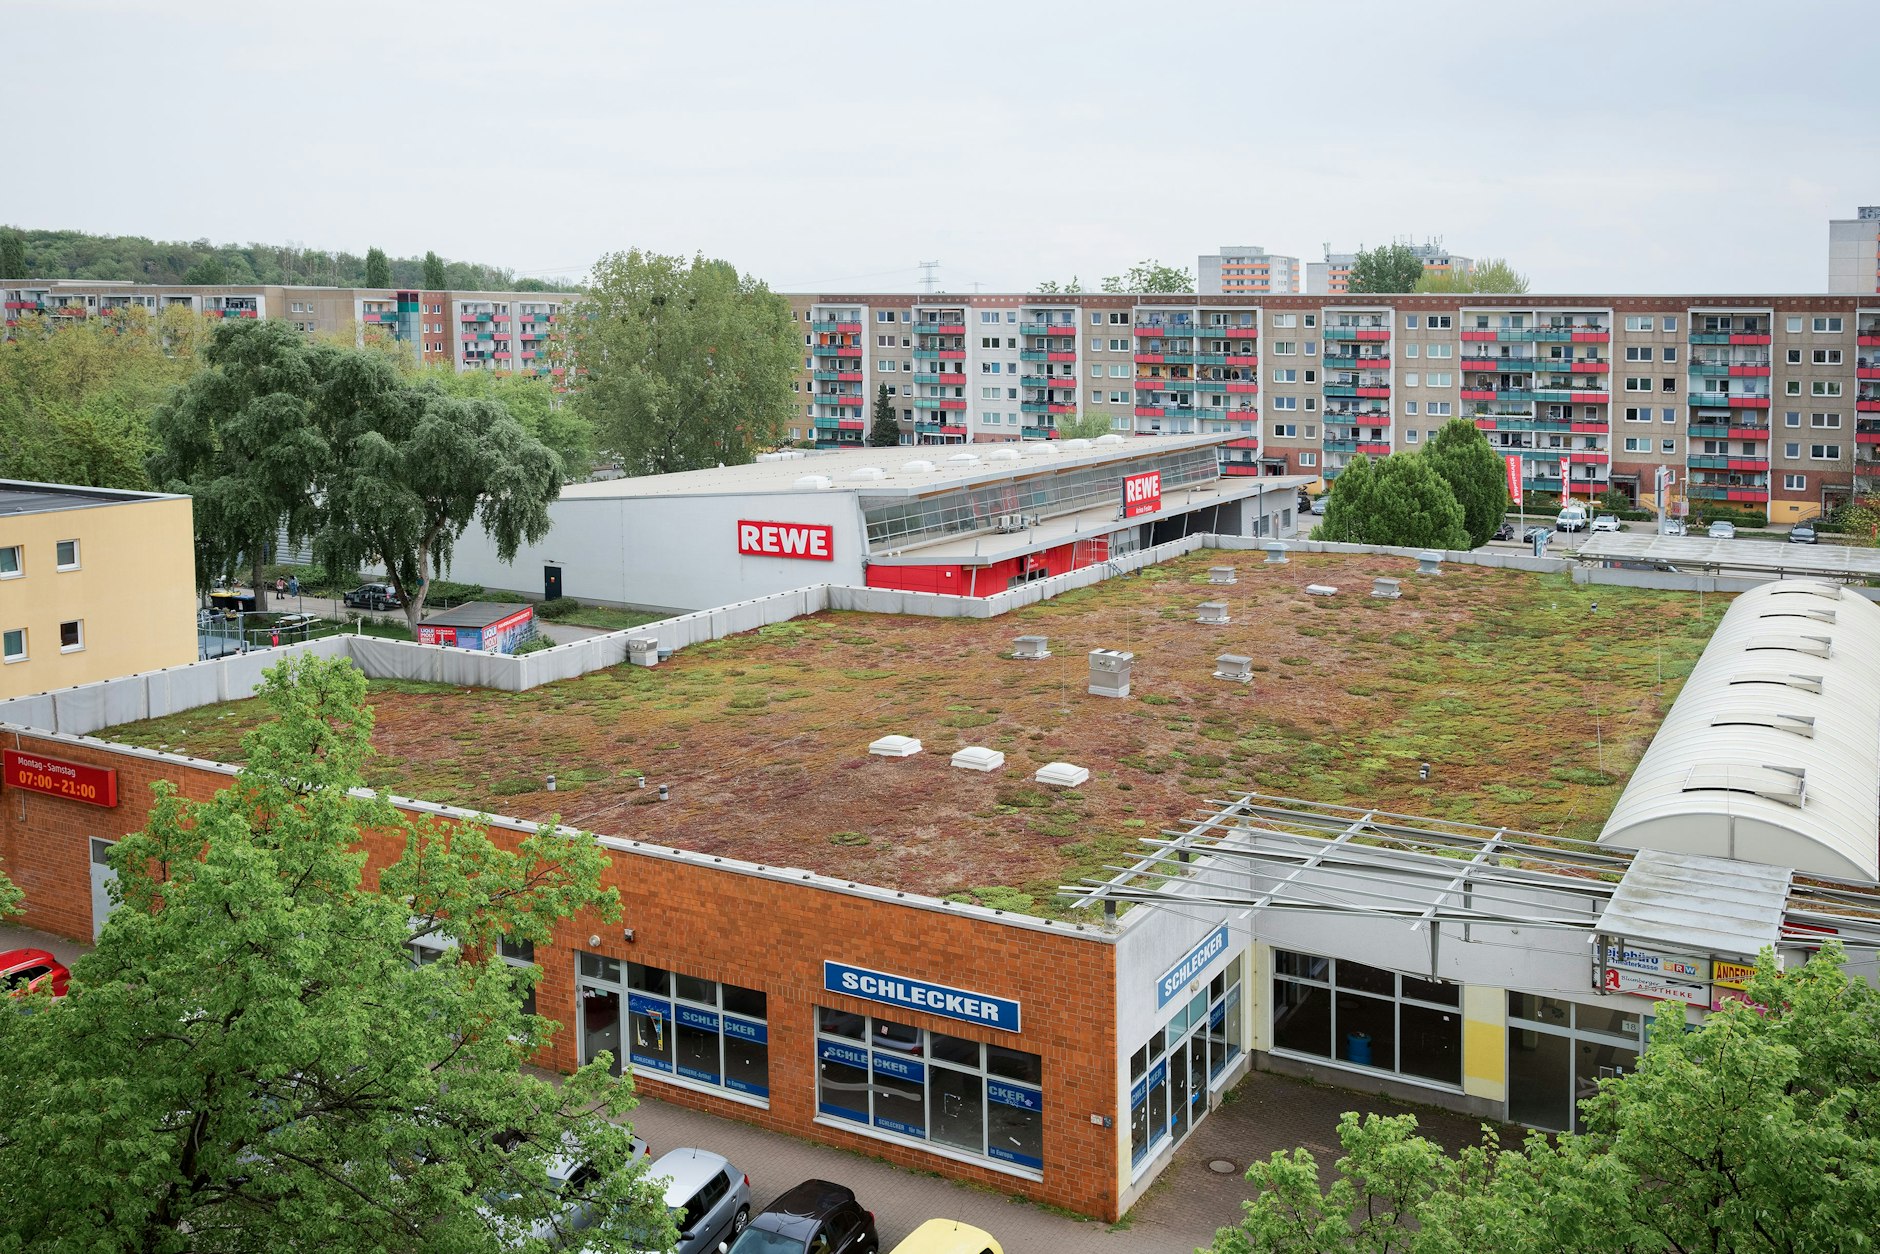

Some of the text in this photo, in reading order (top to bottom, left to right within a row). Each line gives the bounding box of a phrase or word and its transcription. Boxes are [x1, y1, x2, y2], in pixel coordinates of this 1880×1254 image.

[1127, 475, 1159, 502] REWE
[741, 525, 828, 556] REWE
[19, 771, 52, 789] 07:00
[61, 780, 96, 798] 21:00
[1164, 932, 1223, 997] SCHLECKER
[842, 972, 999, 1022] SCHLECKER
[1637, 984, 1693, 998] APOTHEKE
[682, 1011, 756, 1036] SCHLECKER
[1626, 1023, 1637, 1031] 18
[827, 1046, 908, 1074] SCHLECKER
[878, 1118, 905, 1131] SCHLECKER
